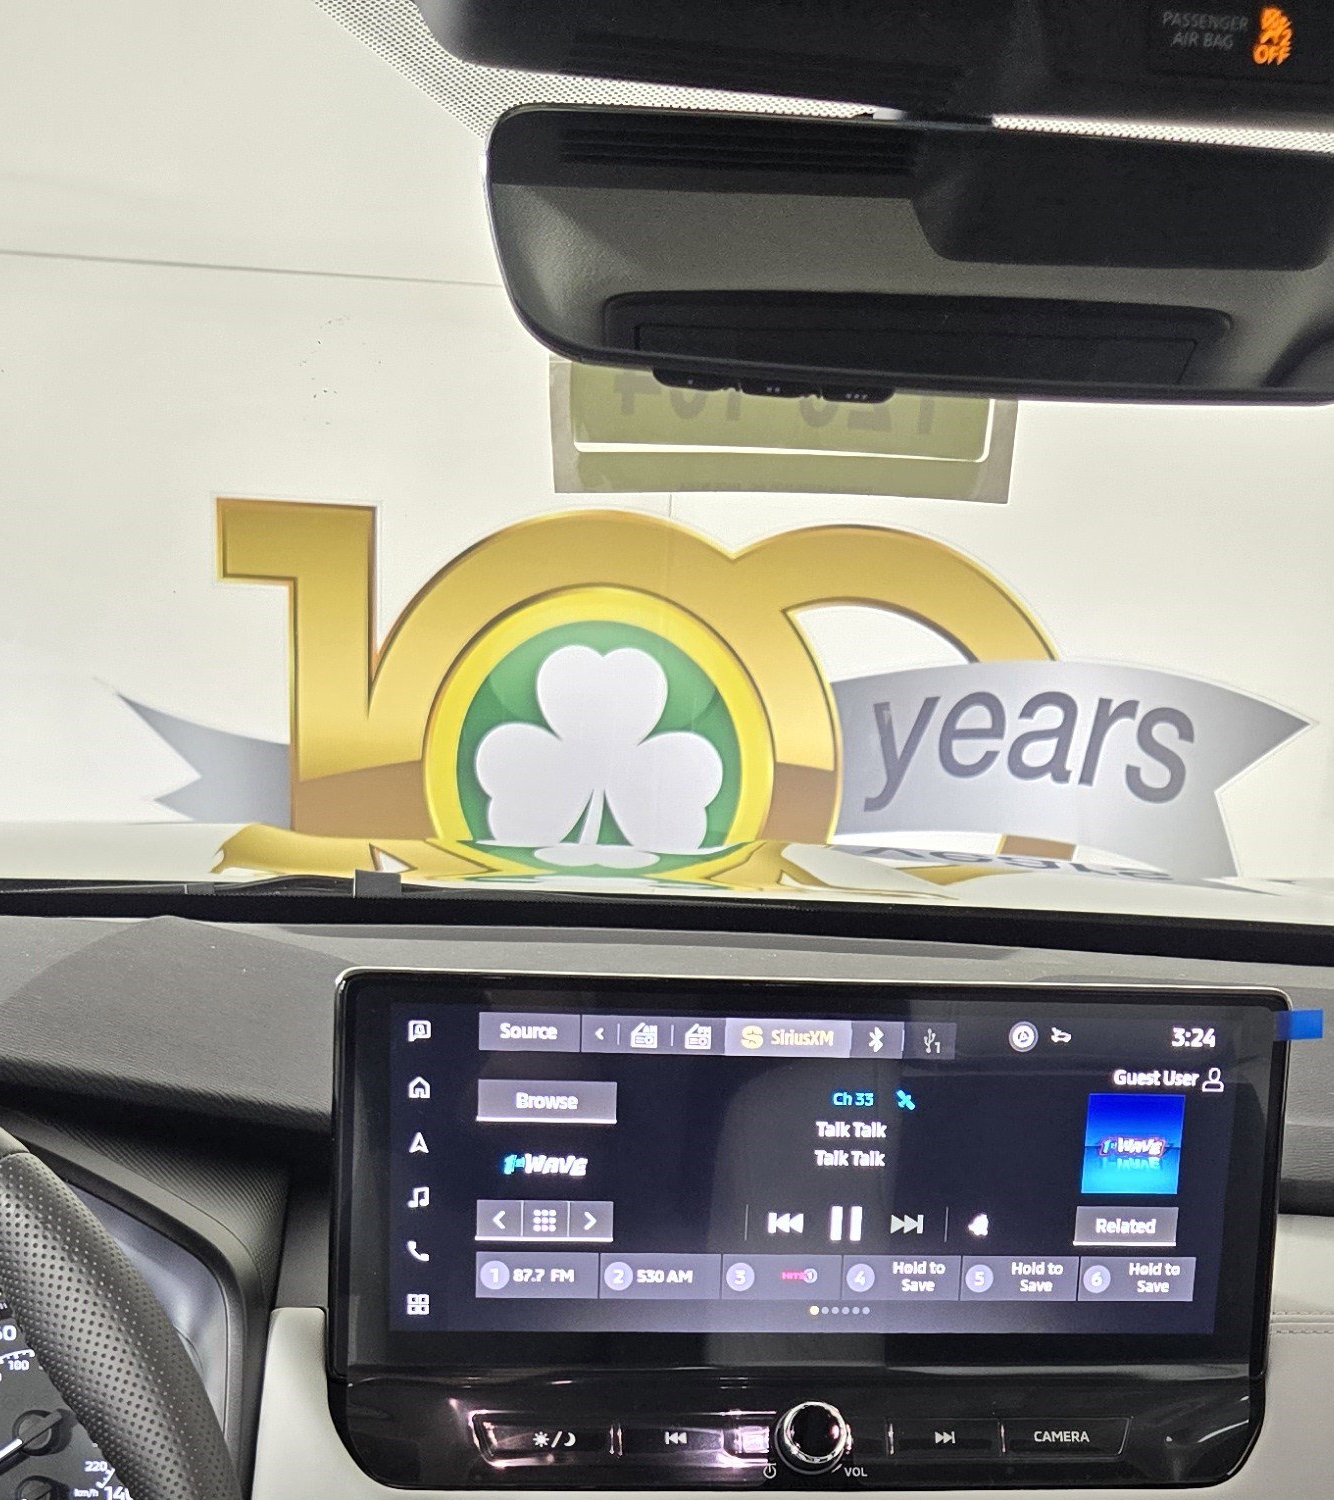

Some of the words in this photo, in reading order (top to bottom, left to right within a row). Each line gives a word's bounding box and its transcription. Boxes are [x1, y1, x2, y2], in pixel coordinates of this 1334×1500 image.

[1162, 11, 1249, 31] PASSENGER
[1170, 31, 1200, 47] AIR
[1202, 32, 1235, 49] BAG
[1253, 44, 1292, 65] OFF
[866, 685, 1196, 811] years
[499, 1022, 558, 1040] Source
[1172, 1027, 1217, 1048] 3:24
[771, 1030, 834, 1047] SiriusXM
[1114, 1070, 1162, 1087] Guest
[1164, 1071, 1200, 1088] User
[516, 1092, 579, 1111] Browse
[833, 1092, 853, 1107] Ch
[855, 1092, 874, 1107] 33
[816, 1122, 852, 1138] Talk
[853, 1122, 887, 1138] Talk
[814, 1150, 850, 1167] Talk
[852, 1150, 886, 1167] Talk
[1095, 1217, 1157, 1236] Related
[893, 1261, 927, 1275] Hold
[929, 1262, 946, 1275] to
[1011, 1262, 1045, 1276] Hold
[1047, 1262, 1064, 1276] to
[1129, 1263, 1163, 1277] Hold
[1164, 1264, 1181, 1277] to
[512, 1269, 544, 1283] 87.7
[550, 1269, 575, 1283] FM
[636, 1270, 665, 1284] 530
[667, 1270, 694, 1284] AM
[901, 1279, 935, 1292] Save
[1020, 1279, 1053, 1293] Save
[1137, 1279, 1170, 1293] Save
[7, 1360, 30, 1371] 100
[1033, 1431, 1091, 1443] CAMERA
[84, 1460, 109, 1472] 220
[844, 1466, 867, 1477] VOL
[73, 1488, 99, 1498] km/h
